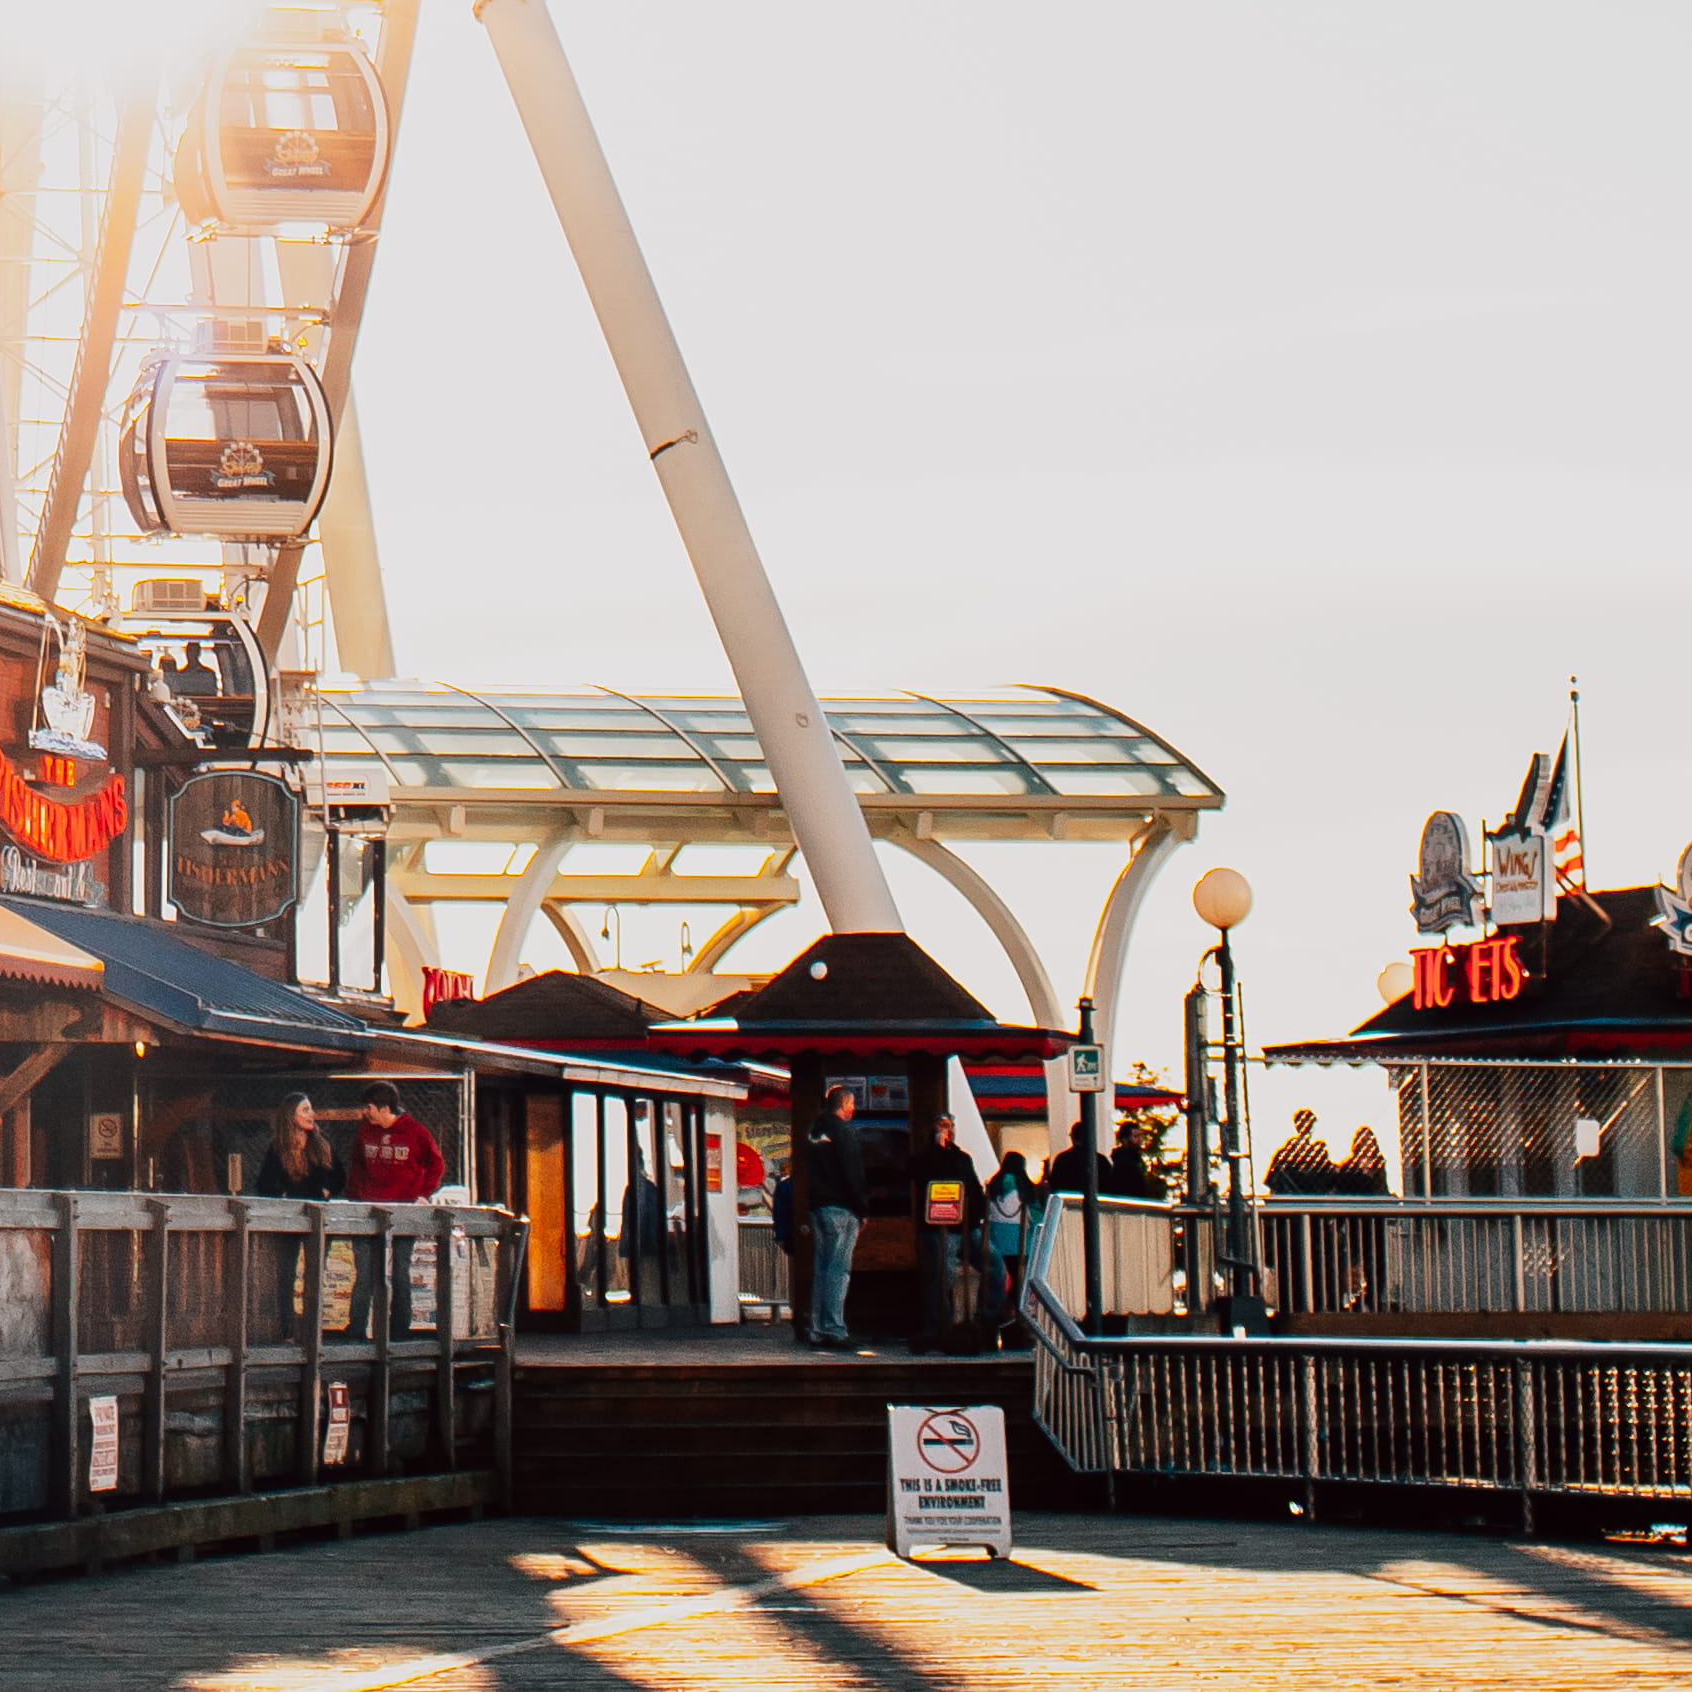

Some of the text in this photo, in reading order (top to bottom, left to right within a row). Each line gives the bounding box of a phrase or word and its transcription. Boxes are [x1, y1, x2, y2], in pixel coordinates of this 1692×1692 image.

[42, 754, 76, 788] THE
[1409, 936, 1522, 1010] TICETS
[900, 1478, 1002, 1492] THIS IS A SMOKE-FREE
[918, 1495, 986, 1509] ENVIRONMENT
